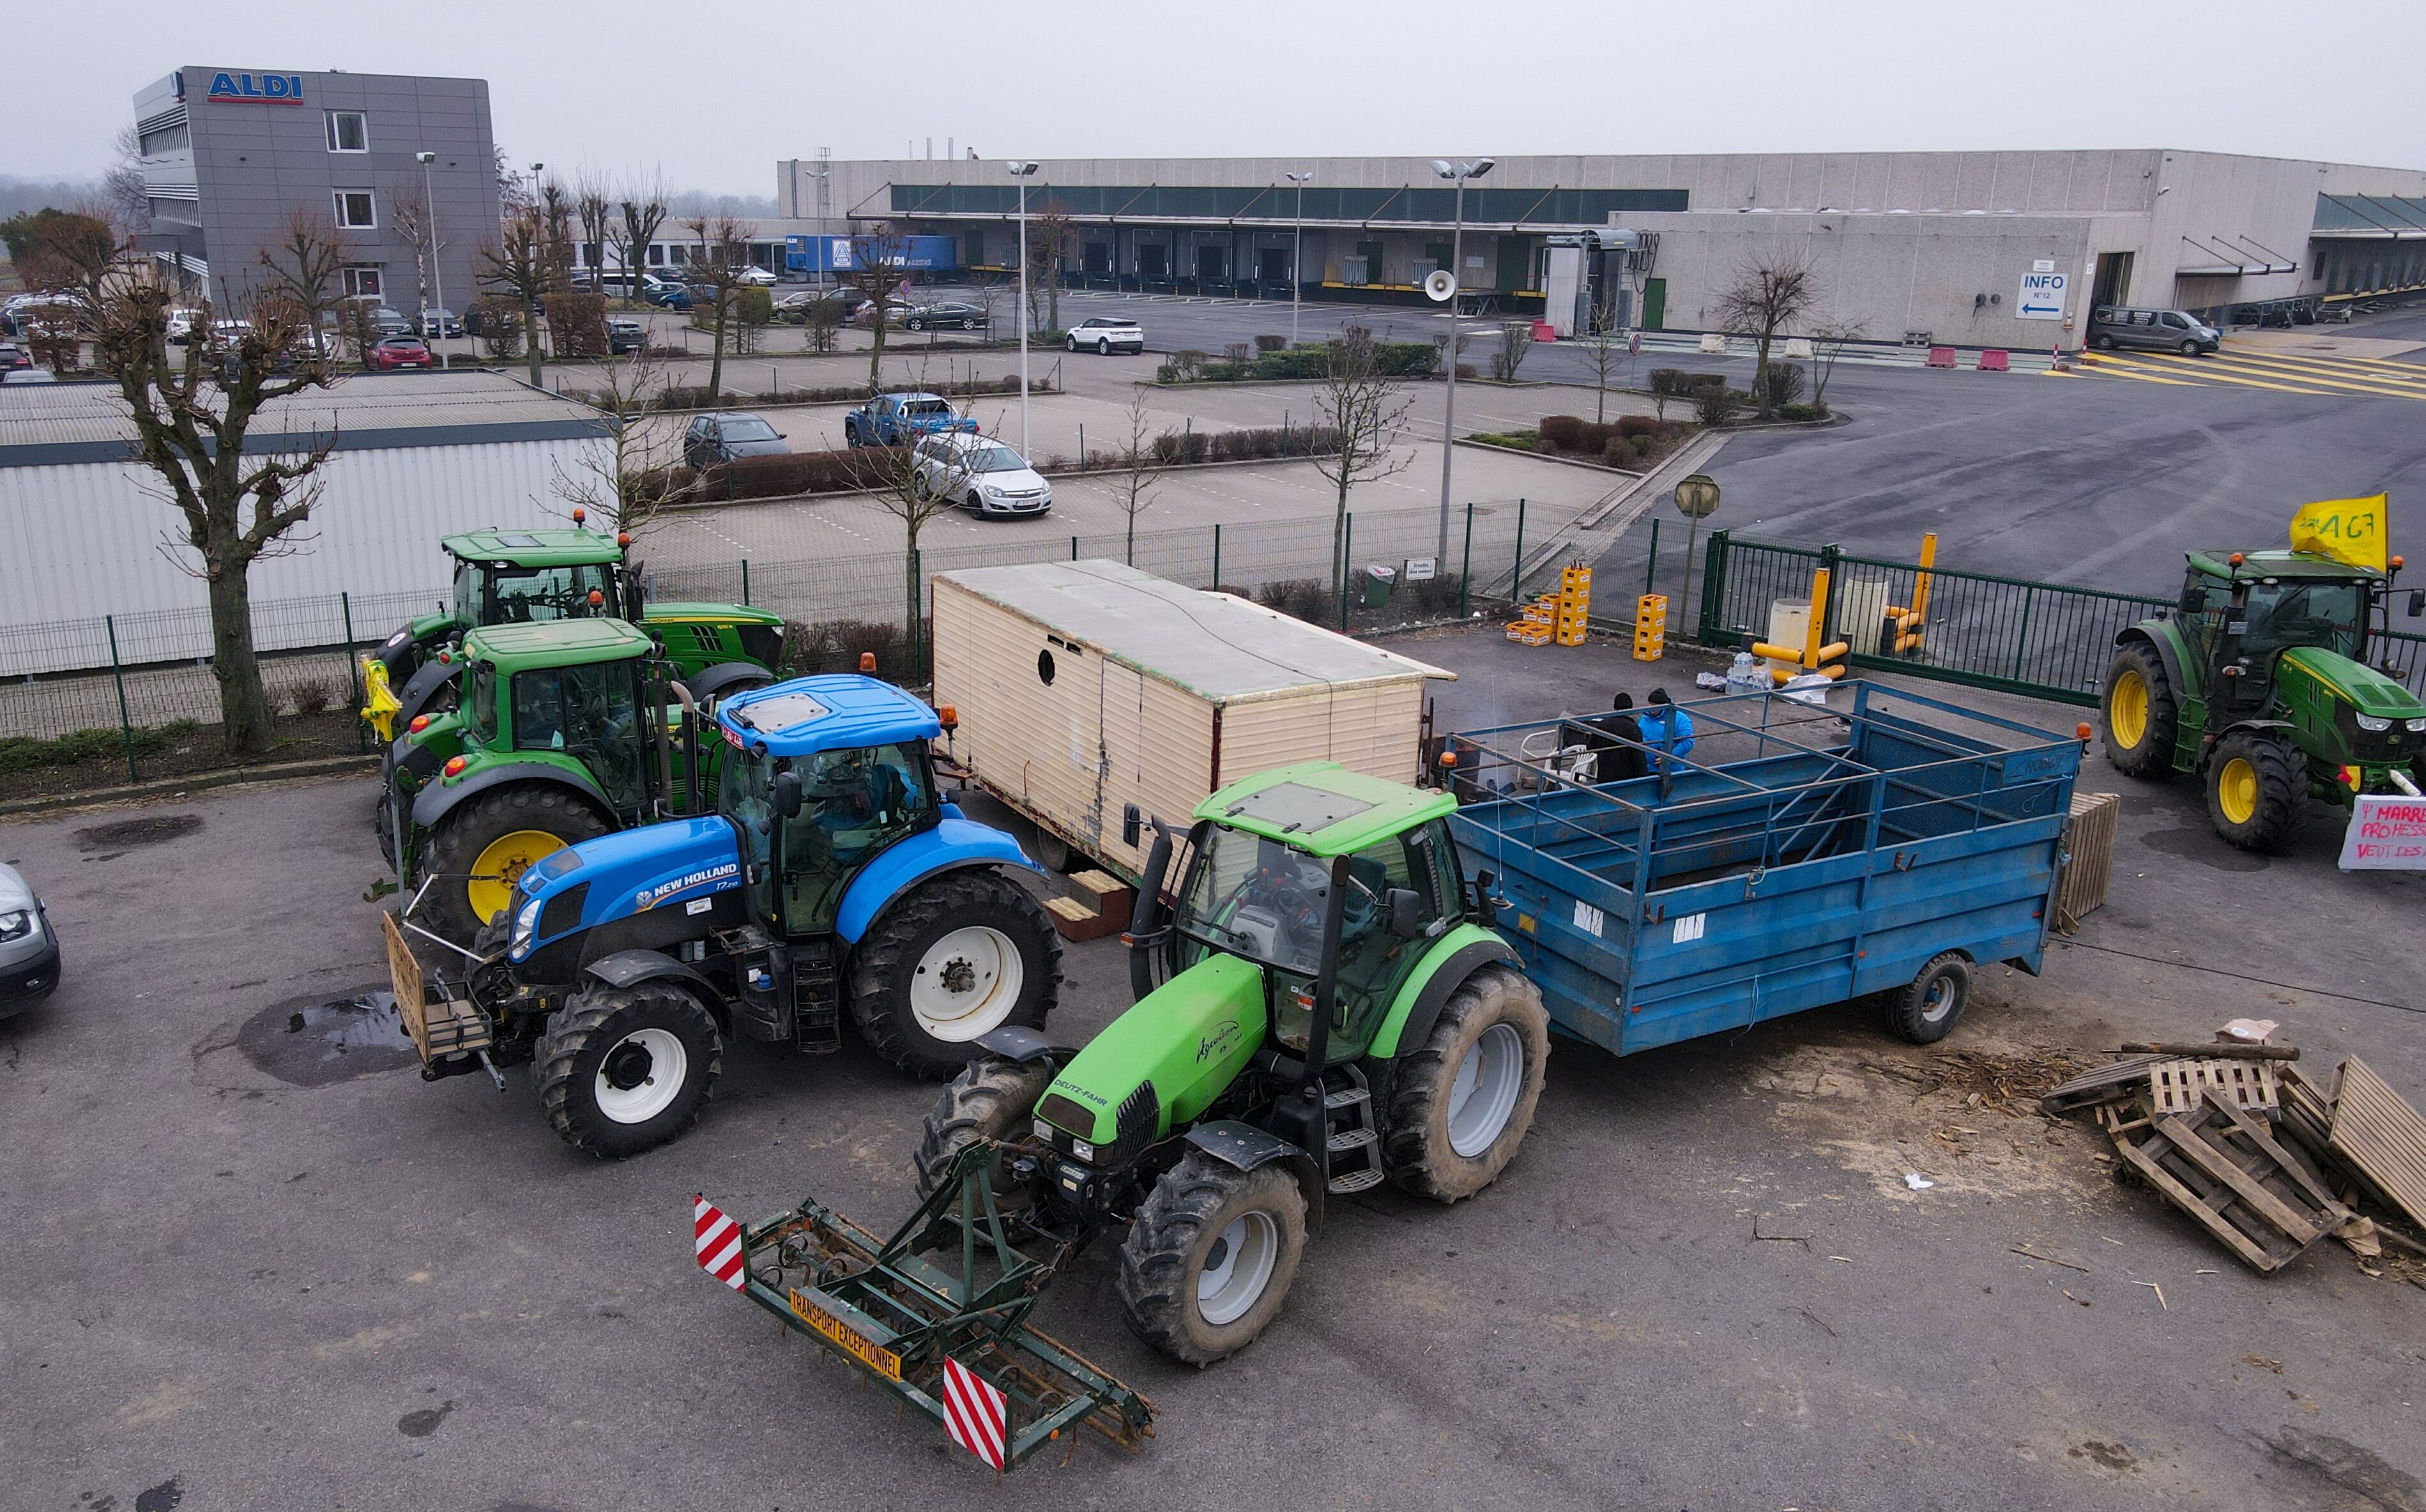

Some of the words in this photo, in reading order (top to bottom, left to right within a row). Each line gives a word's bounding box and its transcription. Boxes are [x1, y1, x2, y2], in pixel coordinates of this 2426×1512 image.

[208, 72, 303, 98] ALDI
[2024, 275, 2064, 289] INFO
[2358, 844, 2394, 859] VEUT
[2394, 846, 2422, 857] DES
[654, 878, 682, 897] NEW
[684, 863, 737, 886] HOLLAND
[1054, 1079, 1108, 1107] DEUTZ-FAHR
[791, 1291, 837, 1338] TRANSPORT
[838, 1322, 897, 1379] EXCEPTIONNEL
